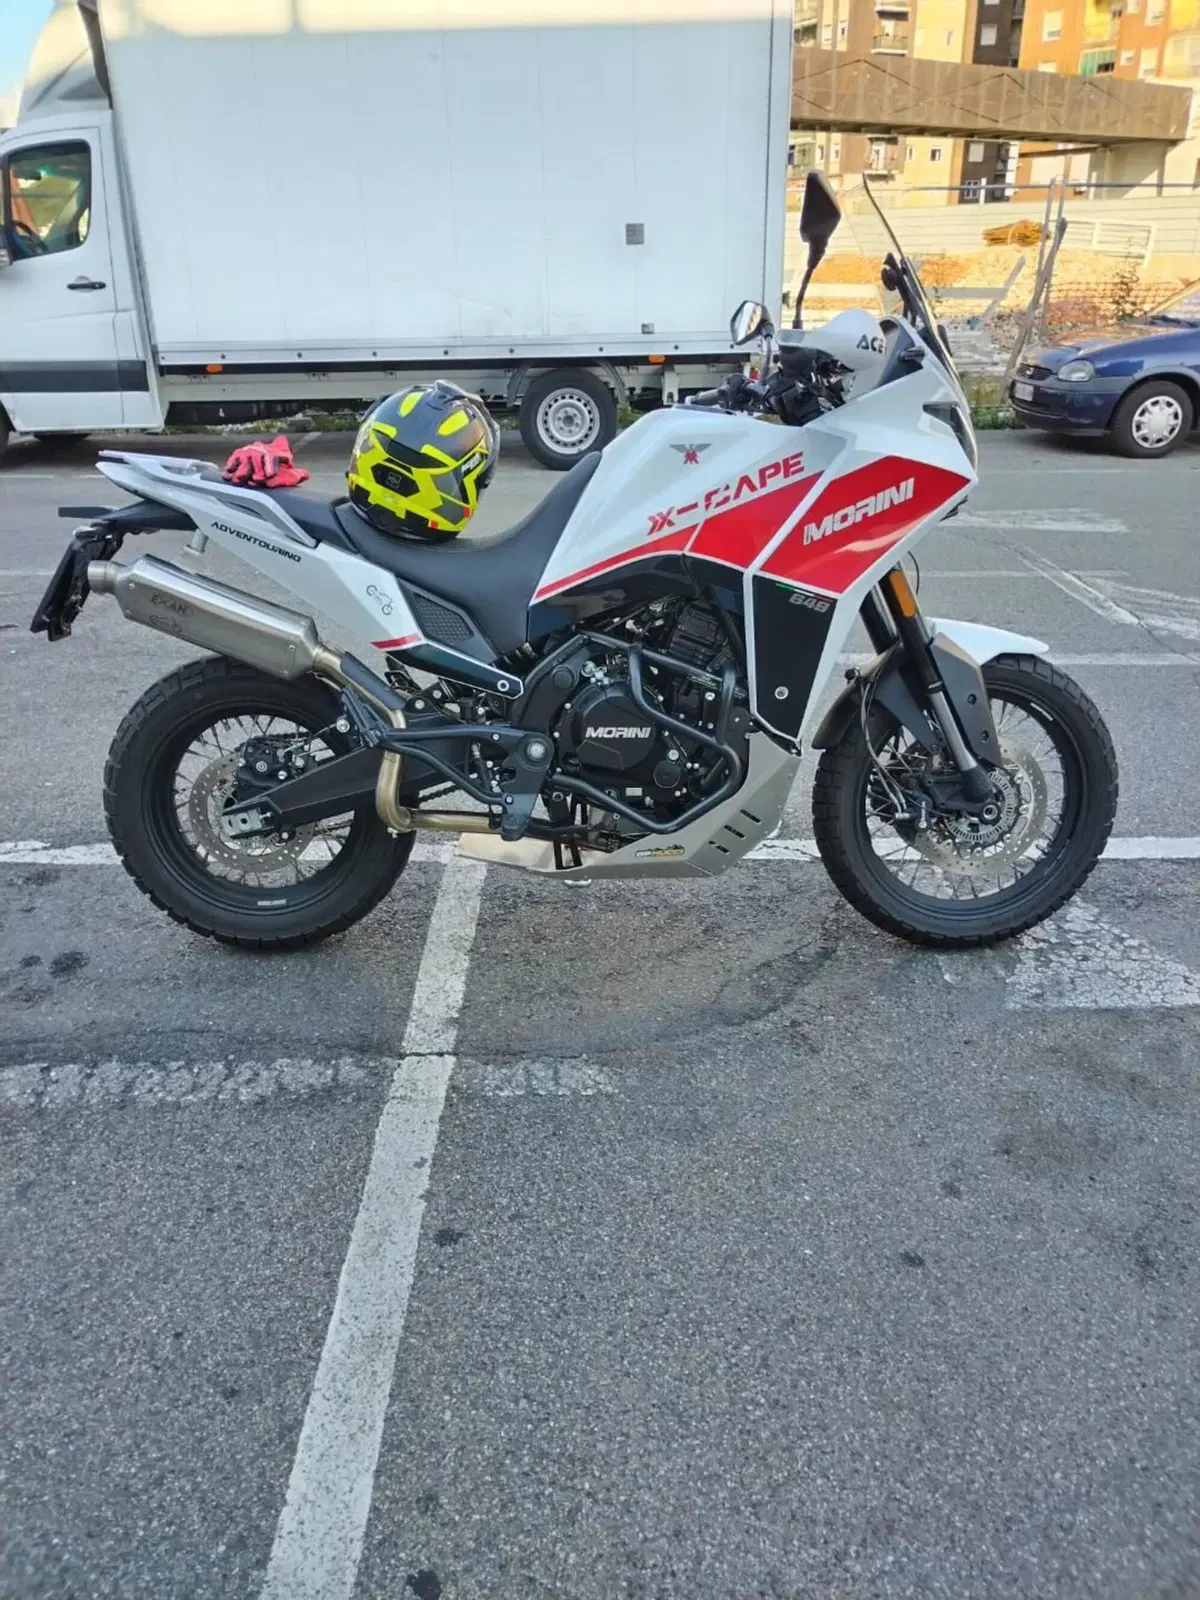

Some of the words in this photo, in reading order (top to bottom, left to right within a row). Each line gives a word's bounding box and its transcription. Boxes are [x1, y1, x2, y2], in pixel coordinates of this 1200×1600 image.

[647, 451, 805, 536] X-CAPE
[803, 477, 915, 546] MORINI
[211, 521, 302, 563] ADVENTOURING
[789, 592, 830, 613] 649
[585, 726, 652, 739] MORINI
